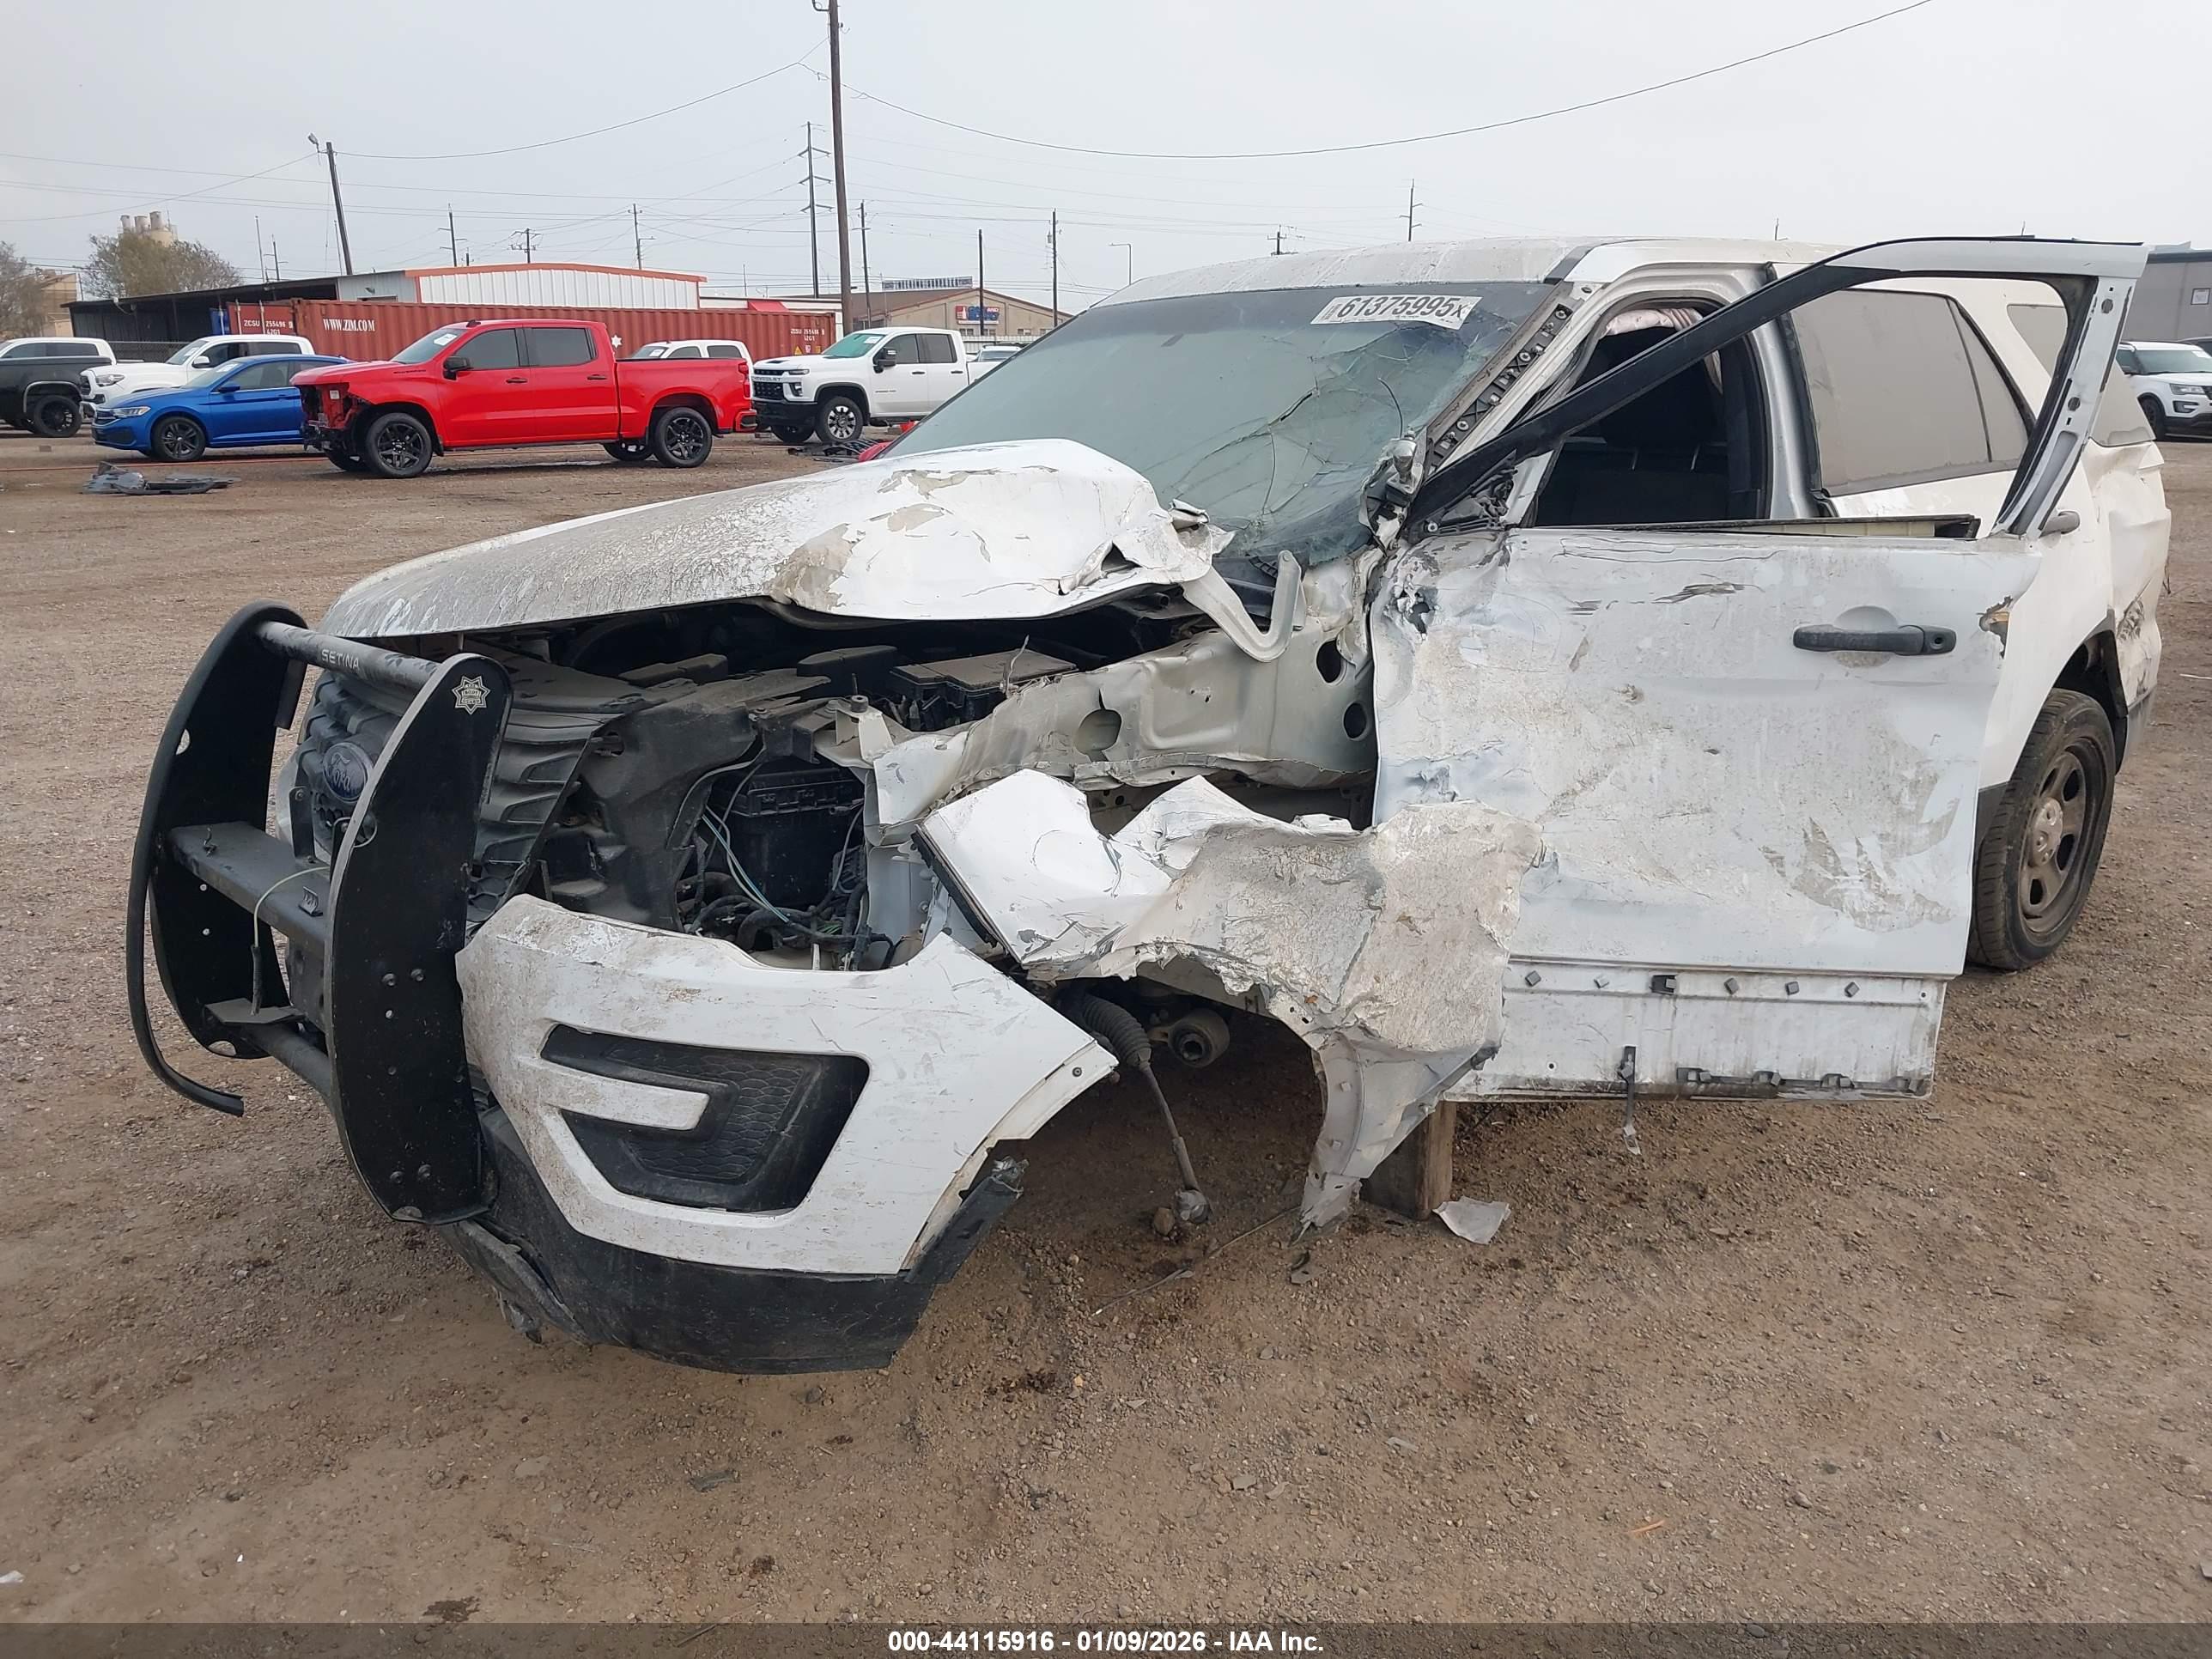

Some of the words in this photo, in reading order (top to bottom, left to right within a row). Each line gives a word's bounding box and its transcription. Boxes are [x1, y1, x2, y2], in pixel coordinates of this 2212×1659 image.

[1337, 295, 1461, 318] 61375995
[322, 319, 375, 331] WWW.ZIM.COM
[321, 648, 359, 670] SETINA
[328, 750, 351, 793] Ford
